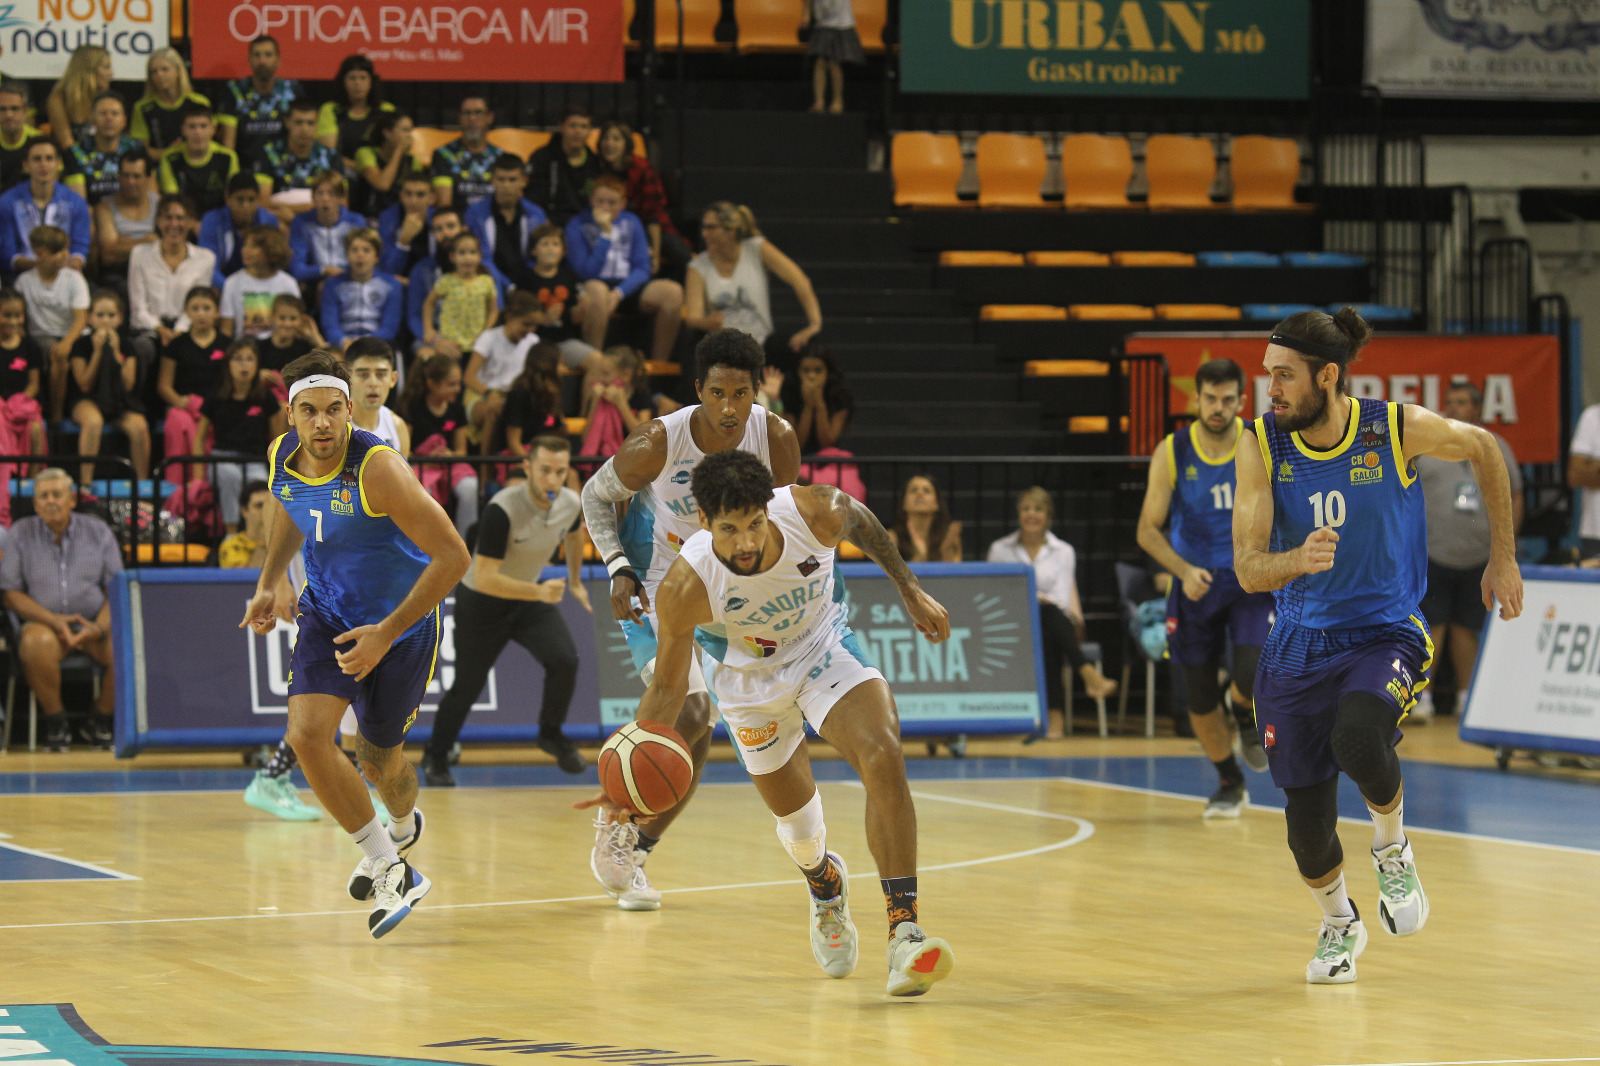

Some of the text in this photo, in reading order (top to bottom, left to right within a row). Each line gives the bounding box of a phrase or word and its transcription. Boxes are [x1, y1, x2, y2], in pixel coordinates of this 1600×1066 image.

[12, 22, 154, 54] náutica
[228, 0, 588, 44] ÓPTICA BARCA MIR
[951, 0, 1211, 51] URBAN
[1028, 56, 1183, 84] Gastrobar
[1351, 455, 1363, 466] CB
[1353, 469, 1379, 481] SALOU
[1210, 482, 1233, 509] 11
[1308, 490, 1346, 528] 10
[309, 508, 324, 543] 7
[1546, 621, 1600, 674] FBI
